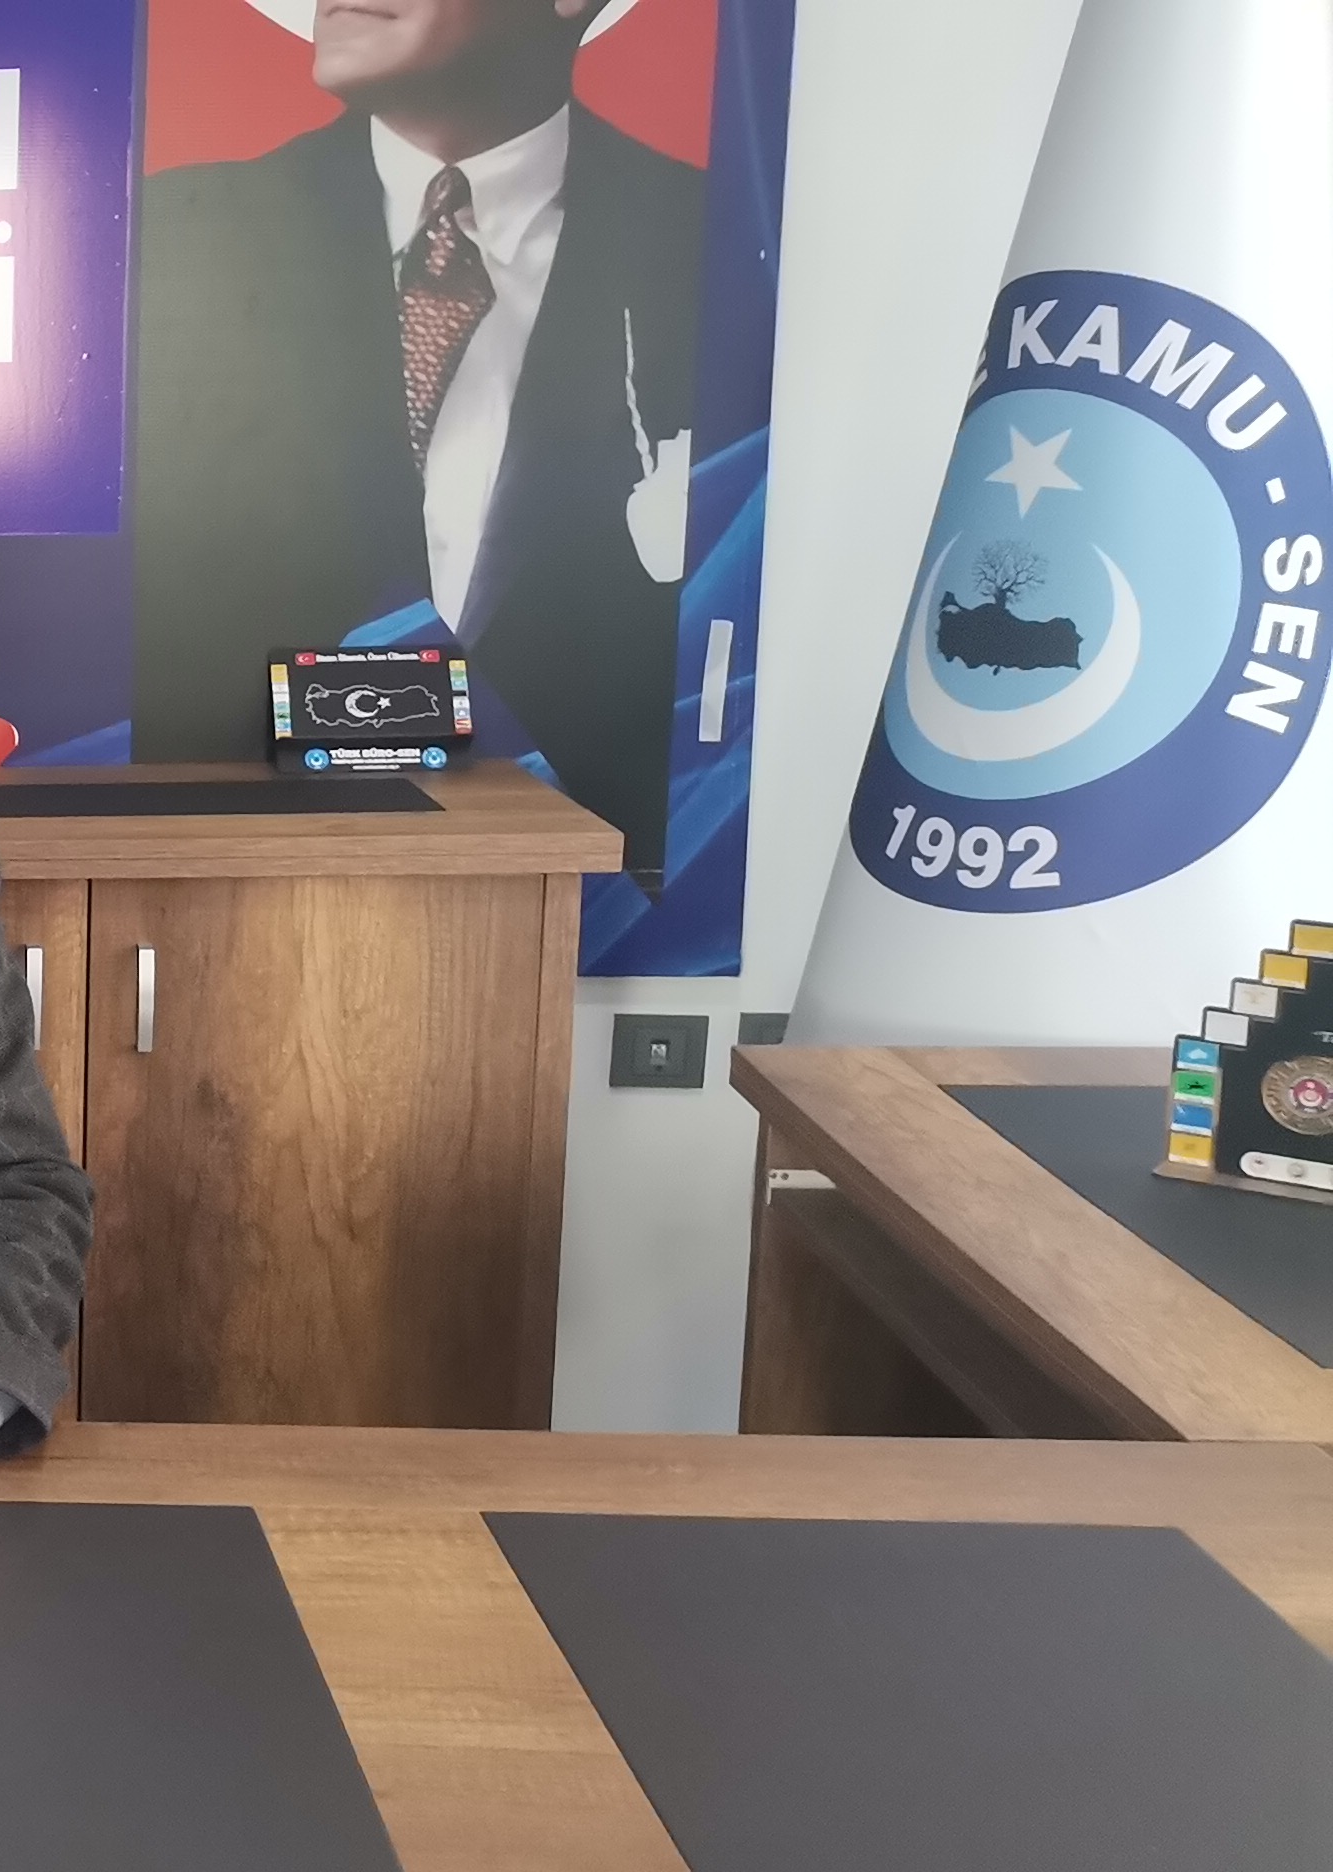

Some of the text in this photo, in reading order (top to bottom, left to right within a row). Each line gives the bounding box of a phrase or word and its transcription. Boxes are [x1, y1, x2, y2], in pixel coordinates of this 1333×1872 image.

[1007, 299, 1287, 452] KAMU
[1224, 533, 1323, 735] SEN
[885, 804, 1061, 890] 1992
